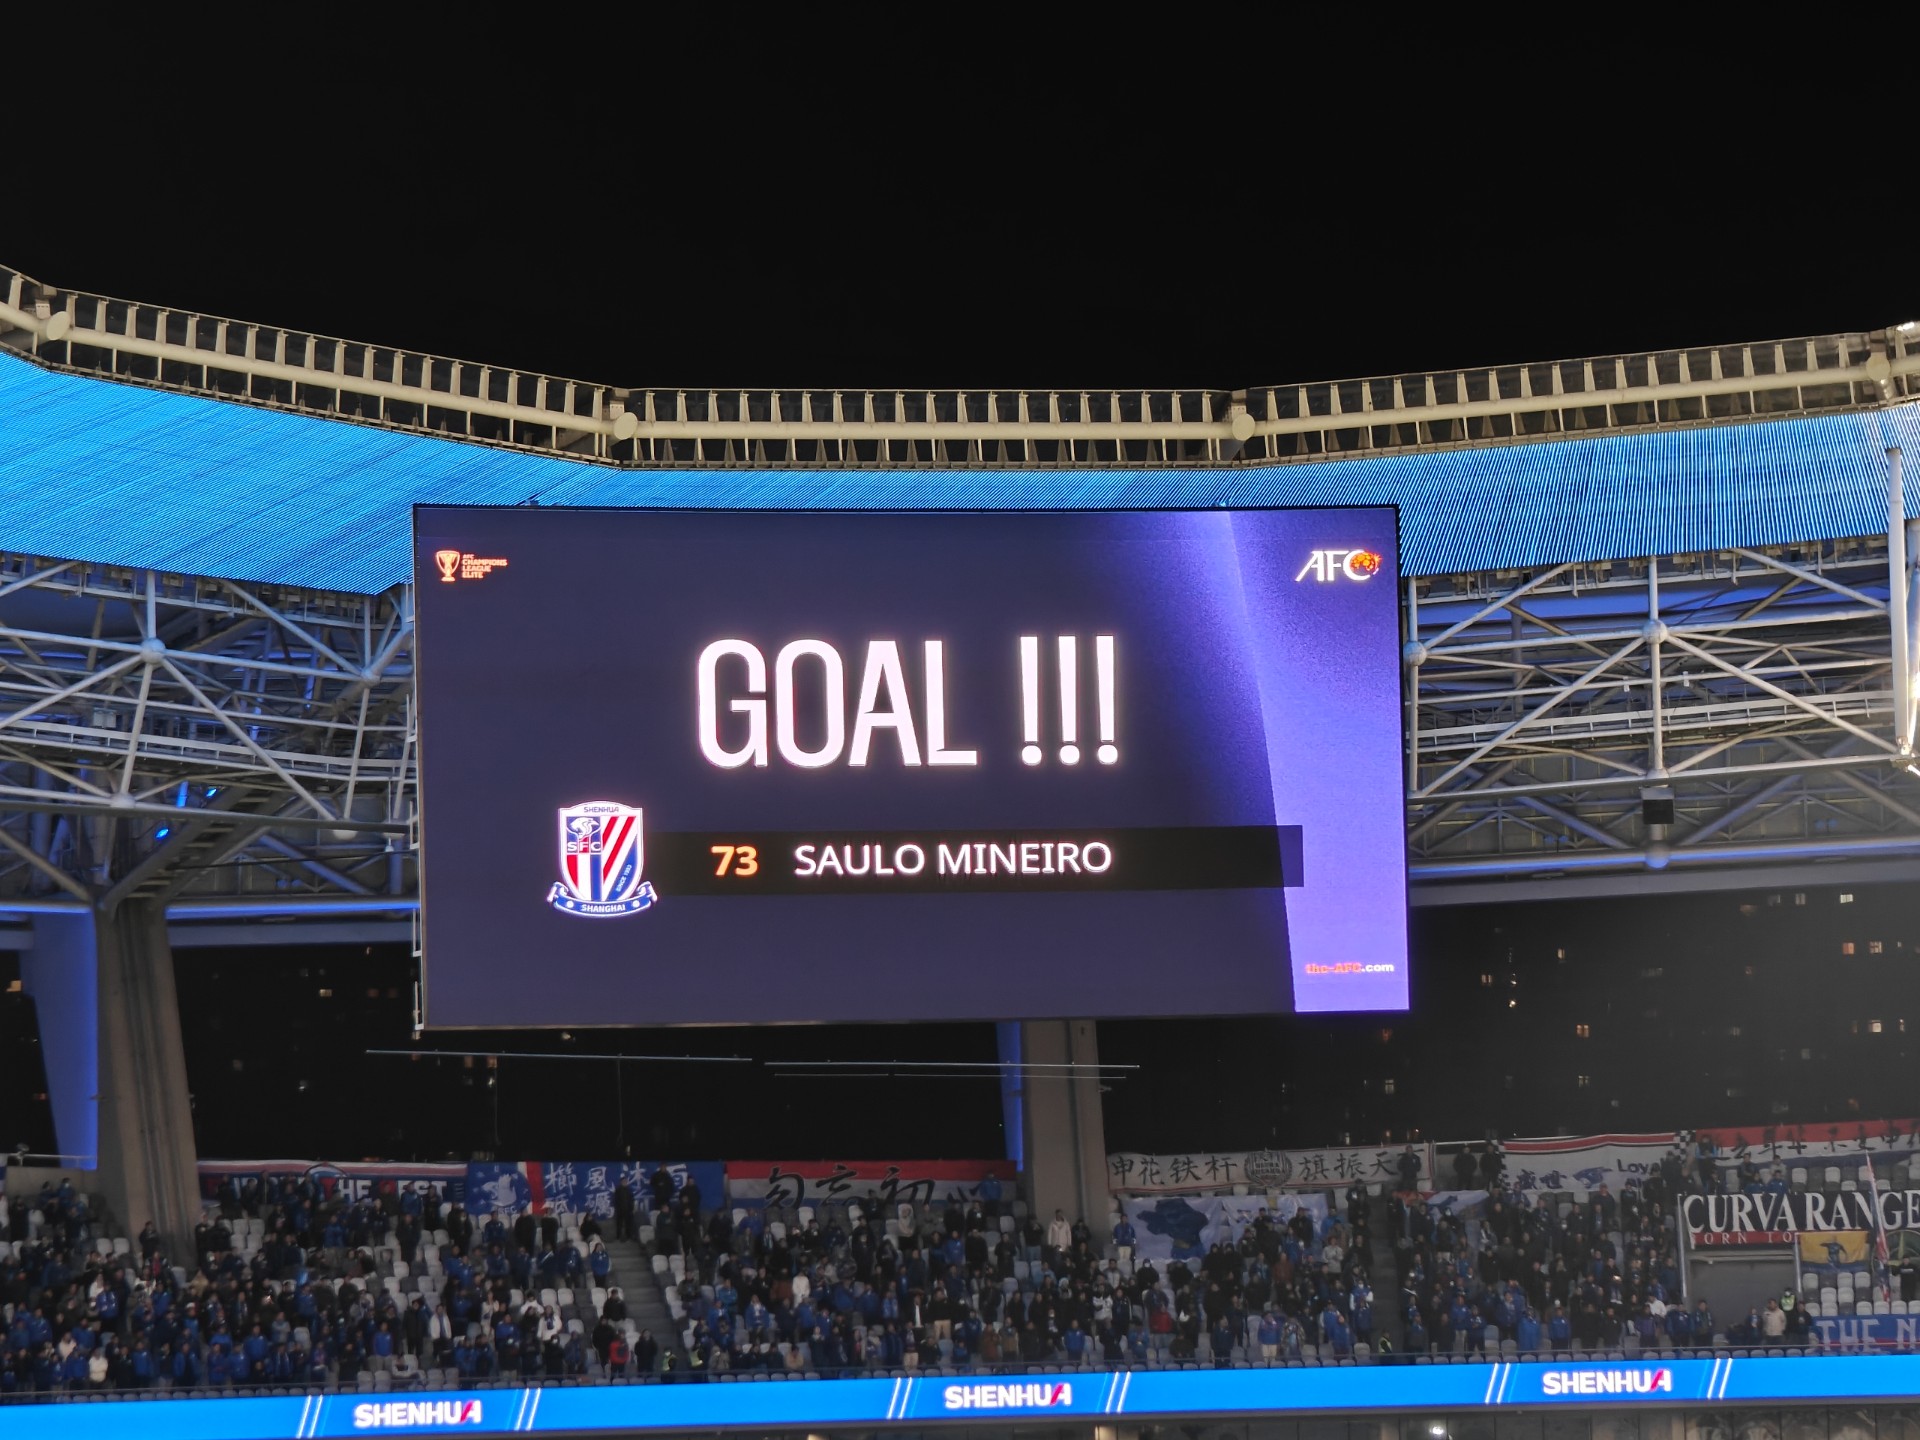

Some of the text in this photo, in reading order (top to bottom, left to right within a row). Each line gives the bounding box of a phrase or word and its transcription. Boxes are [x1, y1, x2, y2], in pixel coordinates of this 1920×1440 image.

[1295, 549, 1380, 581] AFC
[697, 635, 1120, 769] GOAL !!!
[567, 841, 602, 852] SFC
[710, 841, 1112, 877] 73 SAULO MINEIRO
[581, 904, 626, 912] SHANGHAI
[1683, 1193, 1798, 1234] CURVA
[1764, 1231, 1793, 1244] TO
[1815, 1318, 1881, 1353] THE
[943, 1383, 1073, 1409] SHENHUA
[1541, 1368, 1672, 1395] SHENHUA
[353, 1399, 483, 1428] SHENHUA
